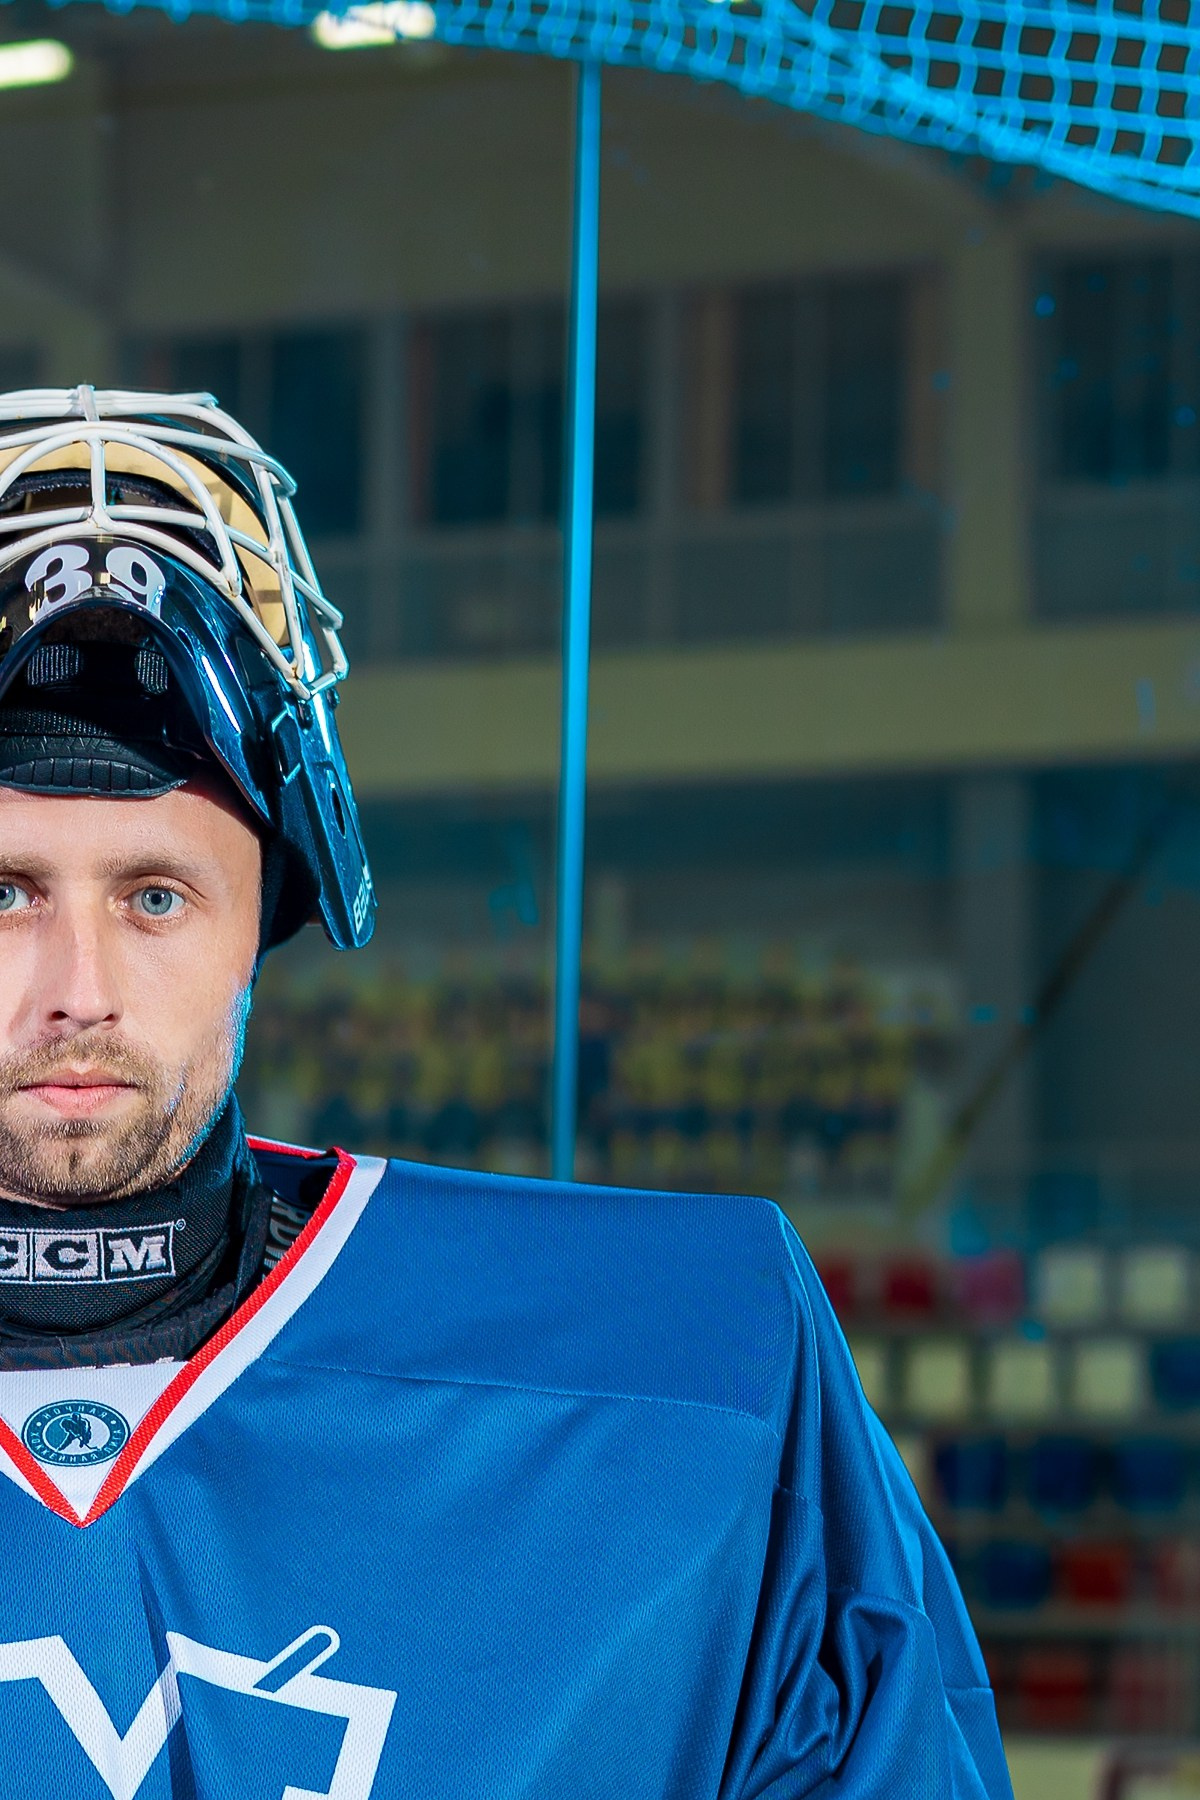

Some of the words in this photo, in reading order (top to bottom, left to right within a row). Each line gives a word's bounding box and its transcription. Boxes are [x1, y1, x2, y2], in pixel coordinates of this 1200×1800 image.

[25, 544, 166, 625] 39
[42, 1405, 108, 1420] НОЧНАЯ
[103, 1429, 122, 1454] ЛИГА
